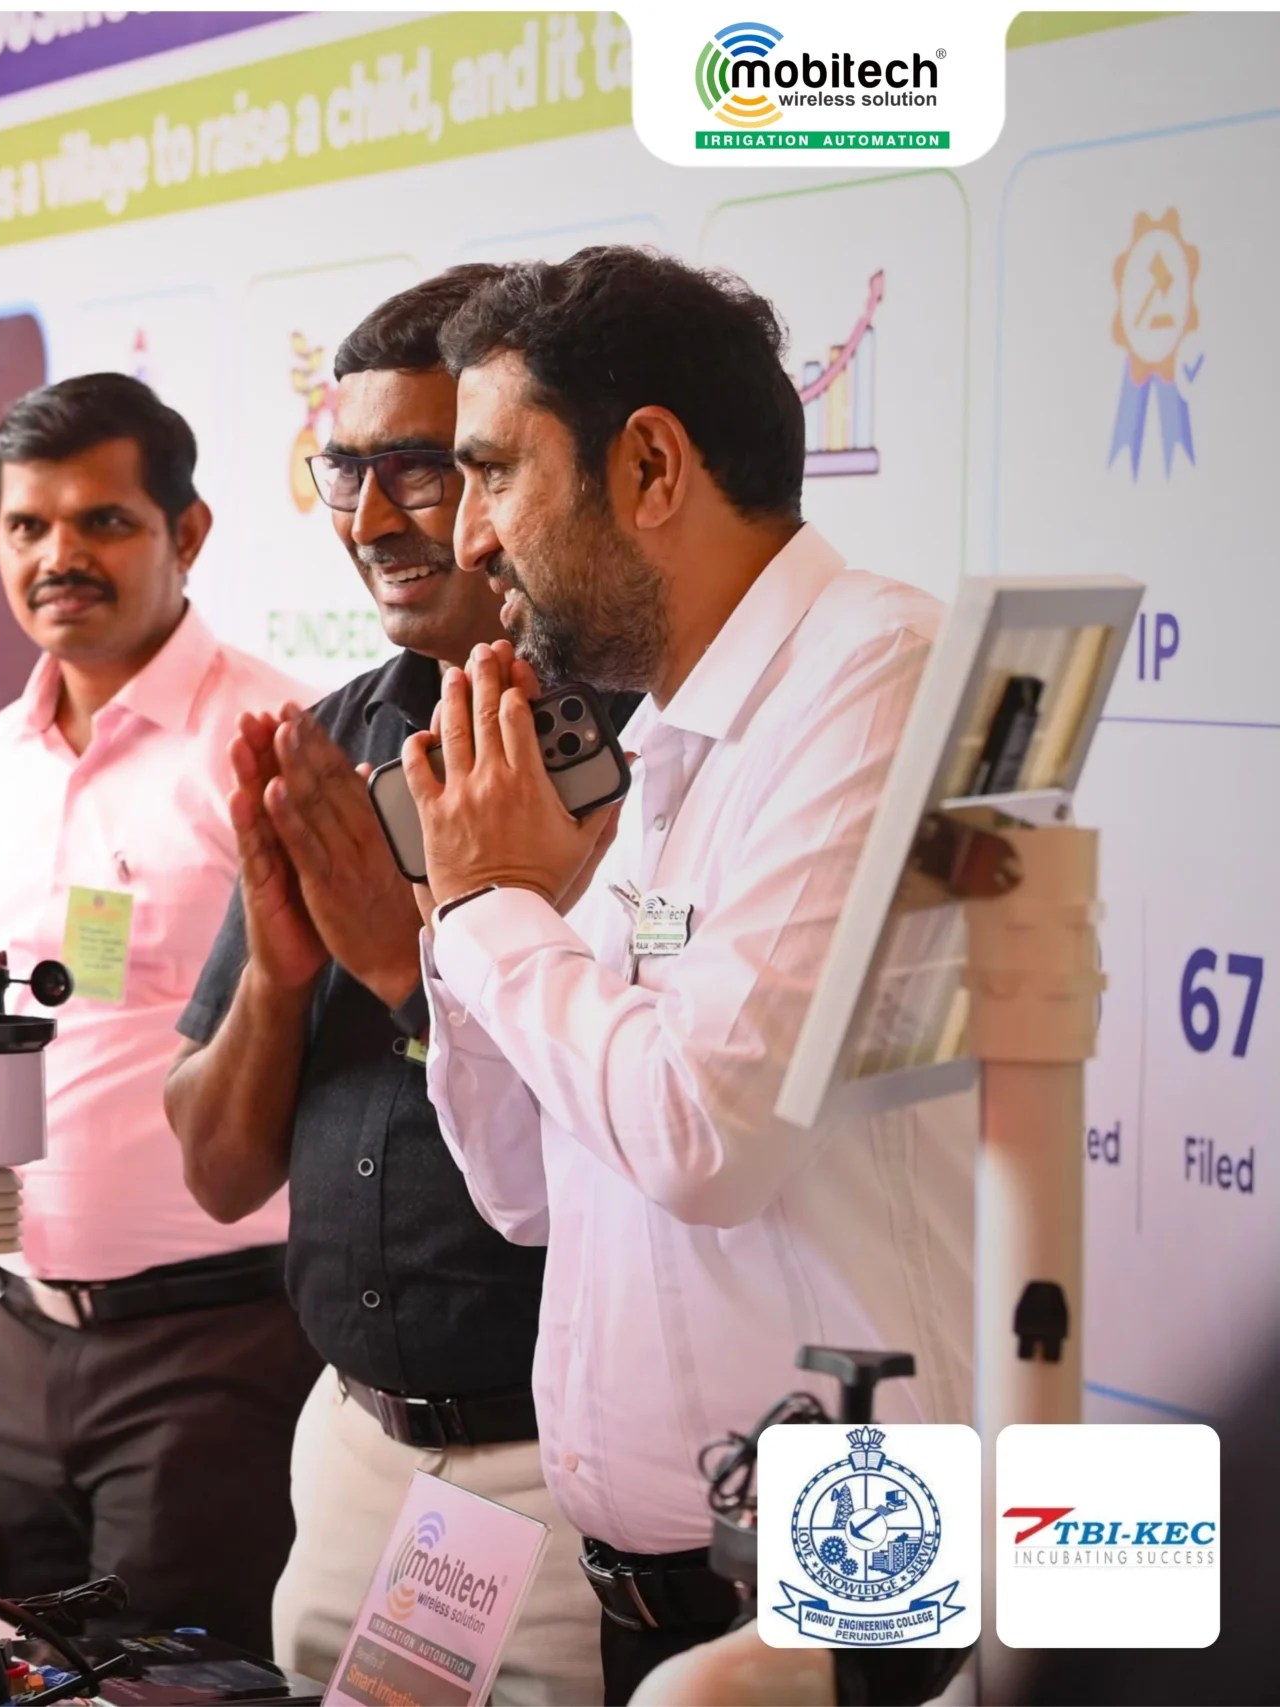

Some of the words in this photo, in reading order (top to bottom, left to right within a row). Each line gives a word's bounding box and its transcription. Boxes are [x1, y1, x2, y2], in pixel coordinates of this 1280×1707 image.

[152, 112, 194, 188] to
[197, 89, 291, 178] raise
[295, 93, 321, 158] a
[326, 46, 445, 143] child,
[448, 14, 539, 124] and
[544, 12, 584, 102] it
[1137, 612, 1180, 681] IP
[1179, 946, 1264, 1059] 67
[1083, 1120, 1122, 1165] ed
[1184, 1135, 1255, 1195] Filed
[404, 1549, 499, 1616] mobitech
[417, 1591, 451, 1618] wireless
[450, 1607, 486, 1635] solution
[371, 1616, 417, 1649] IRRIGATION
[419, 1641, 471, 1678] AUTOMATION
